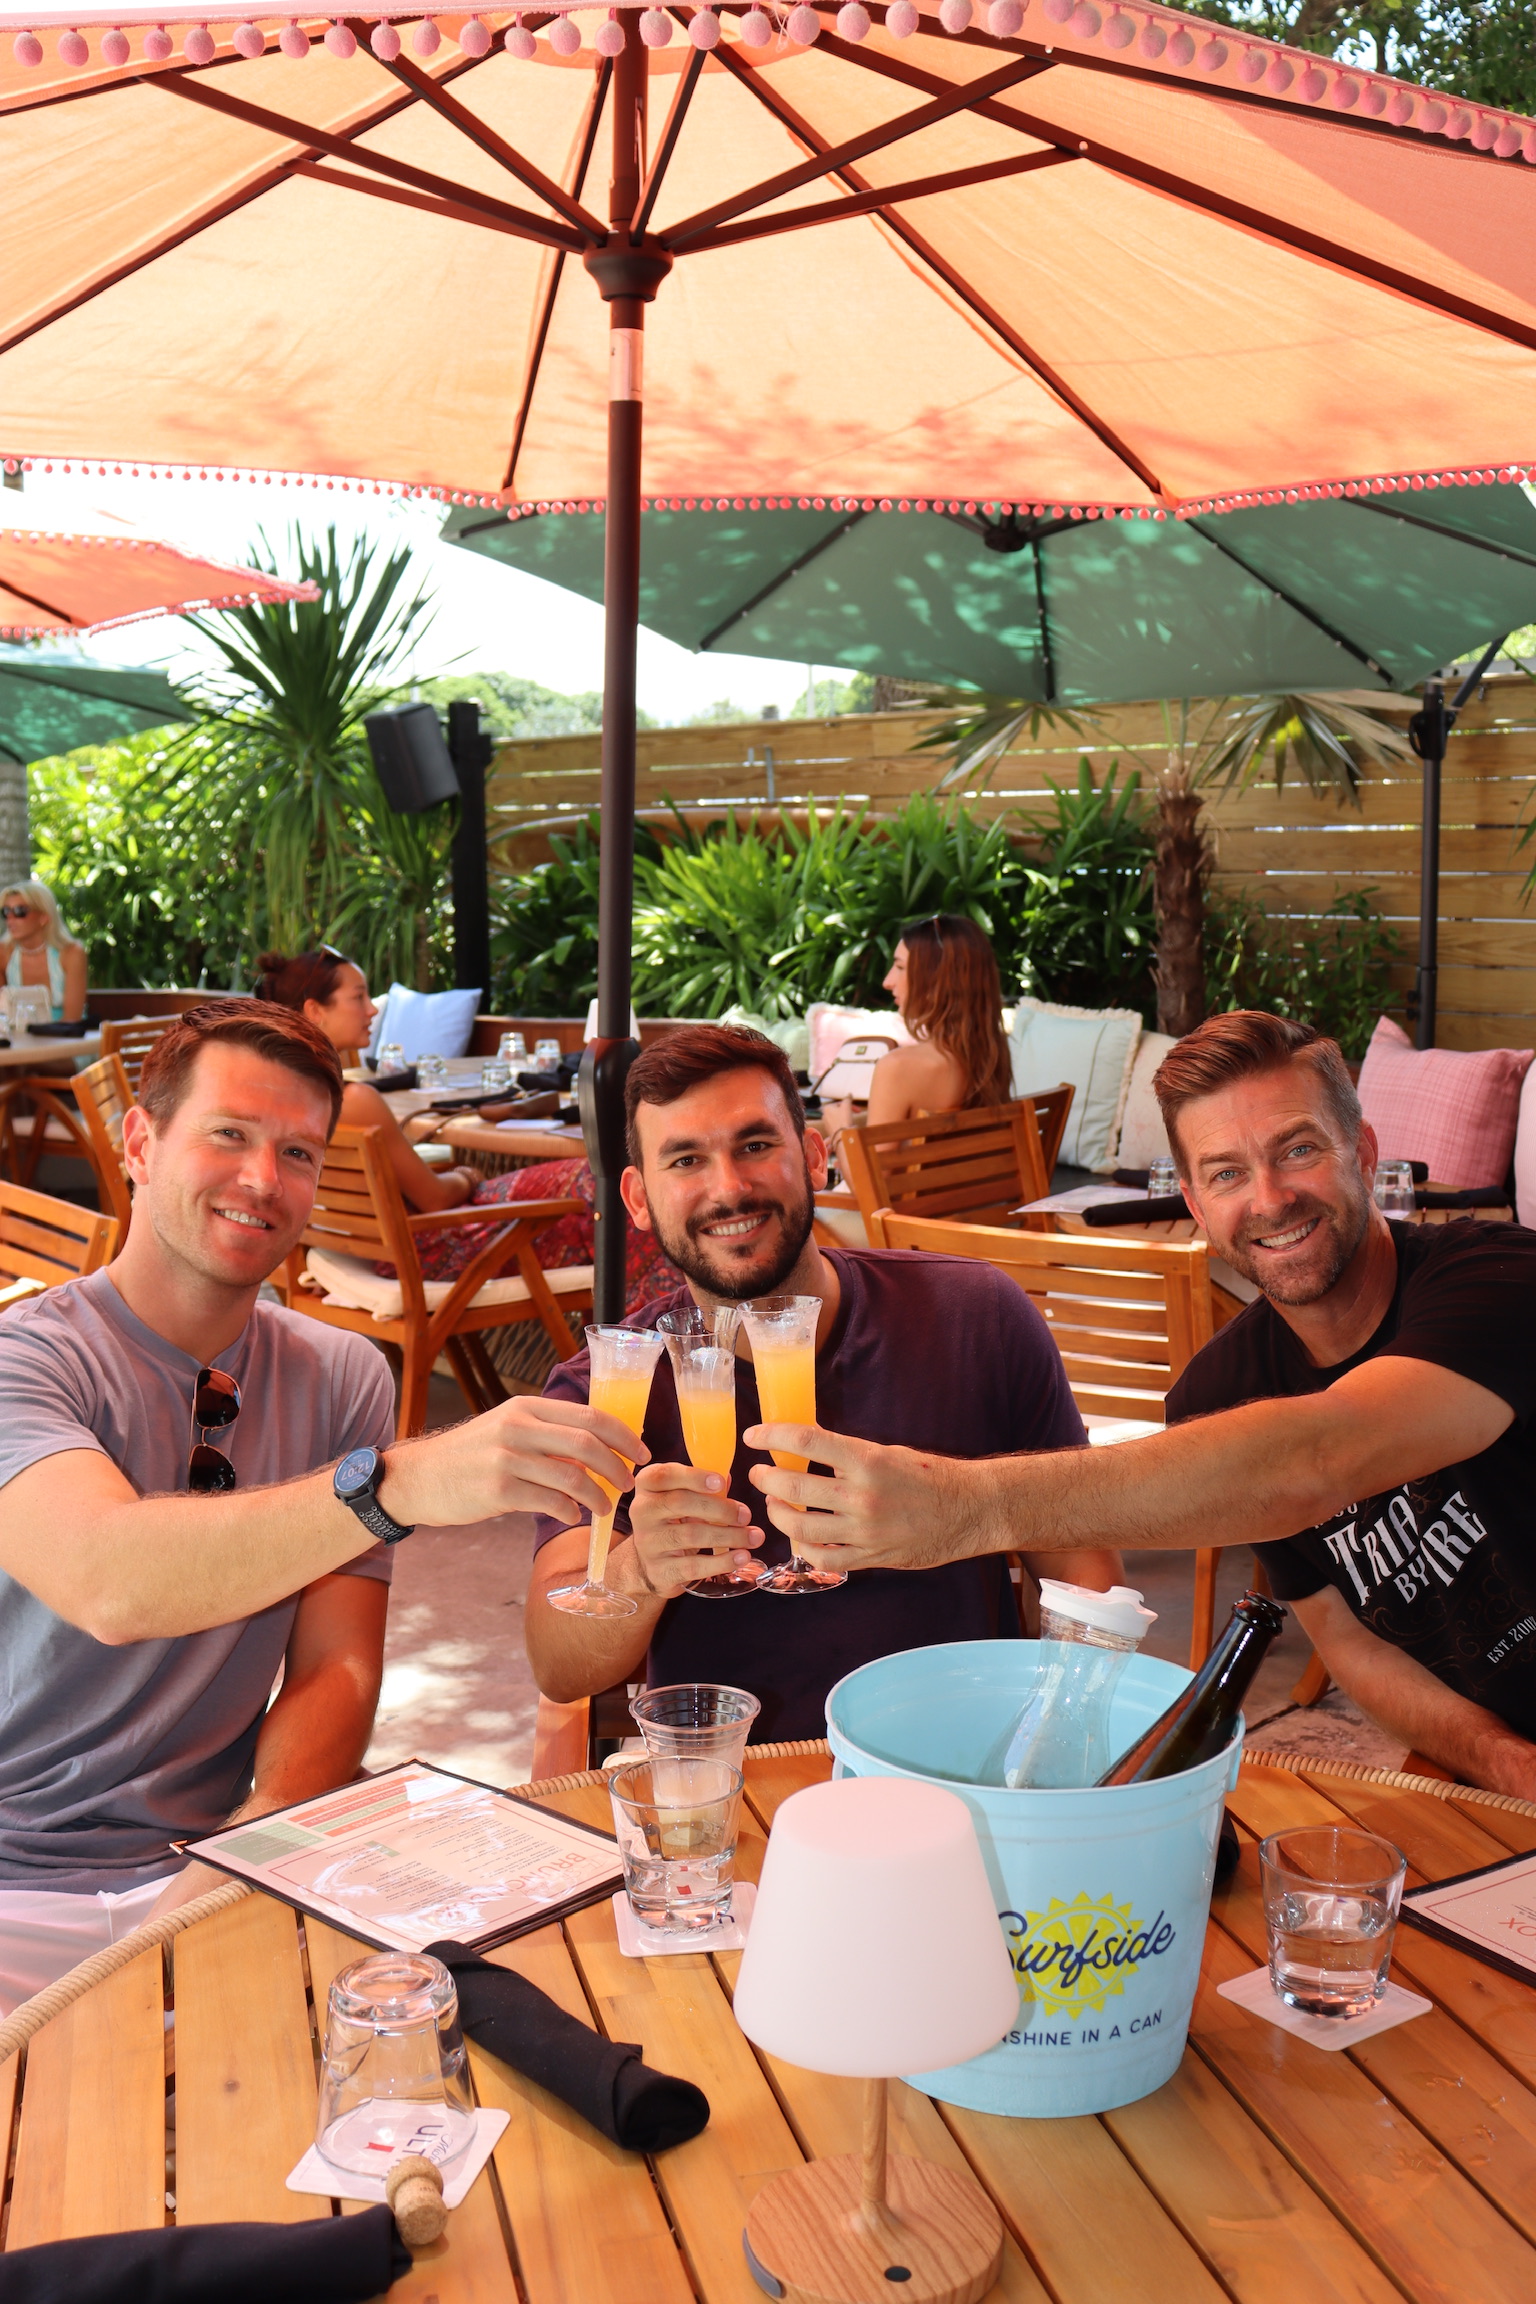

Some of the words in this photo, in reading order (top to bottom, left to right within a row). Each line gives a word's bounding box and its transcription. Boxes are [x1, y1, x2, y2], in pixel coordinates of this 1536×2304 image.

[1323, 1483, 1419, 1607] TRIA
[1419, 1490, 1489, 1588] IRE
[1393, 1554, 1430, 1604] BY
[1486, 1639, 1514, 1664] EST.
[484, 1851, 589, 1896] BRUNCH
[998, 1909, 1176, 1989] Surfside
[1082, 2028, 1099, 2044] IN
[1109, 2025, 1121, 2040] A
[1130, 2009, 1163, 2034] CAN
